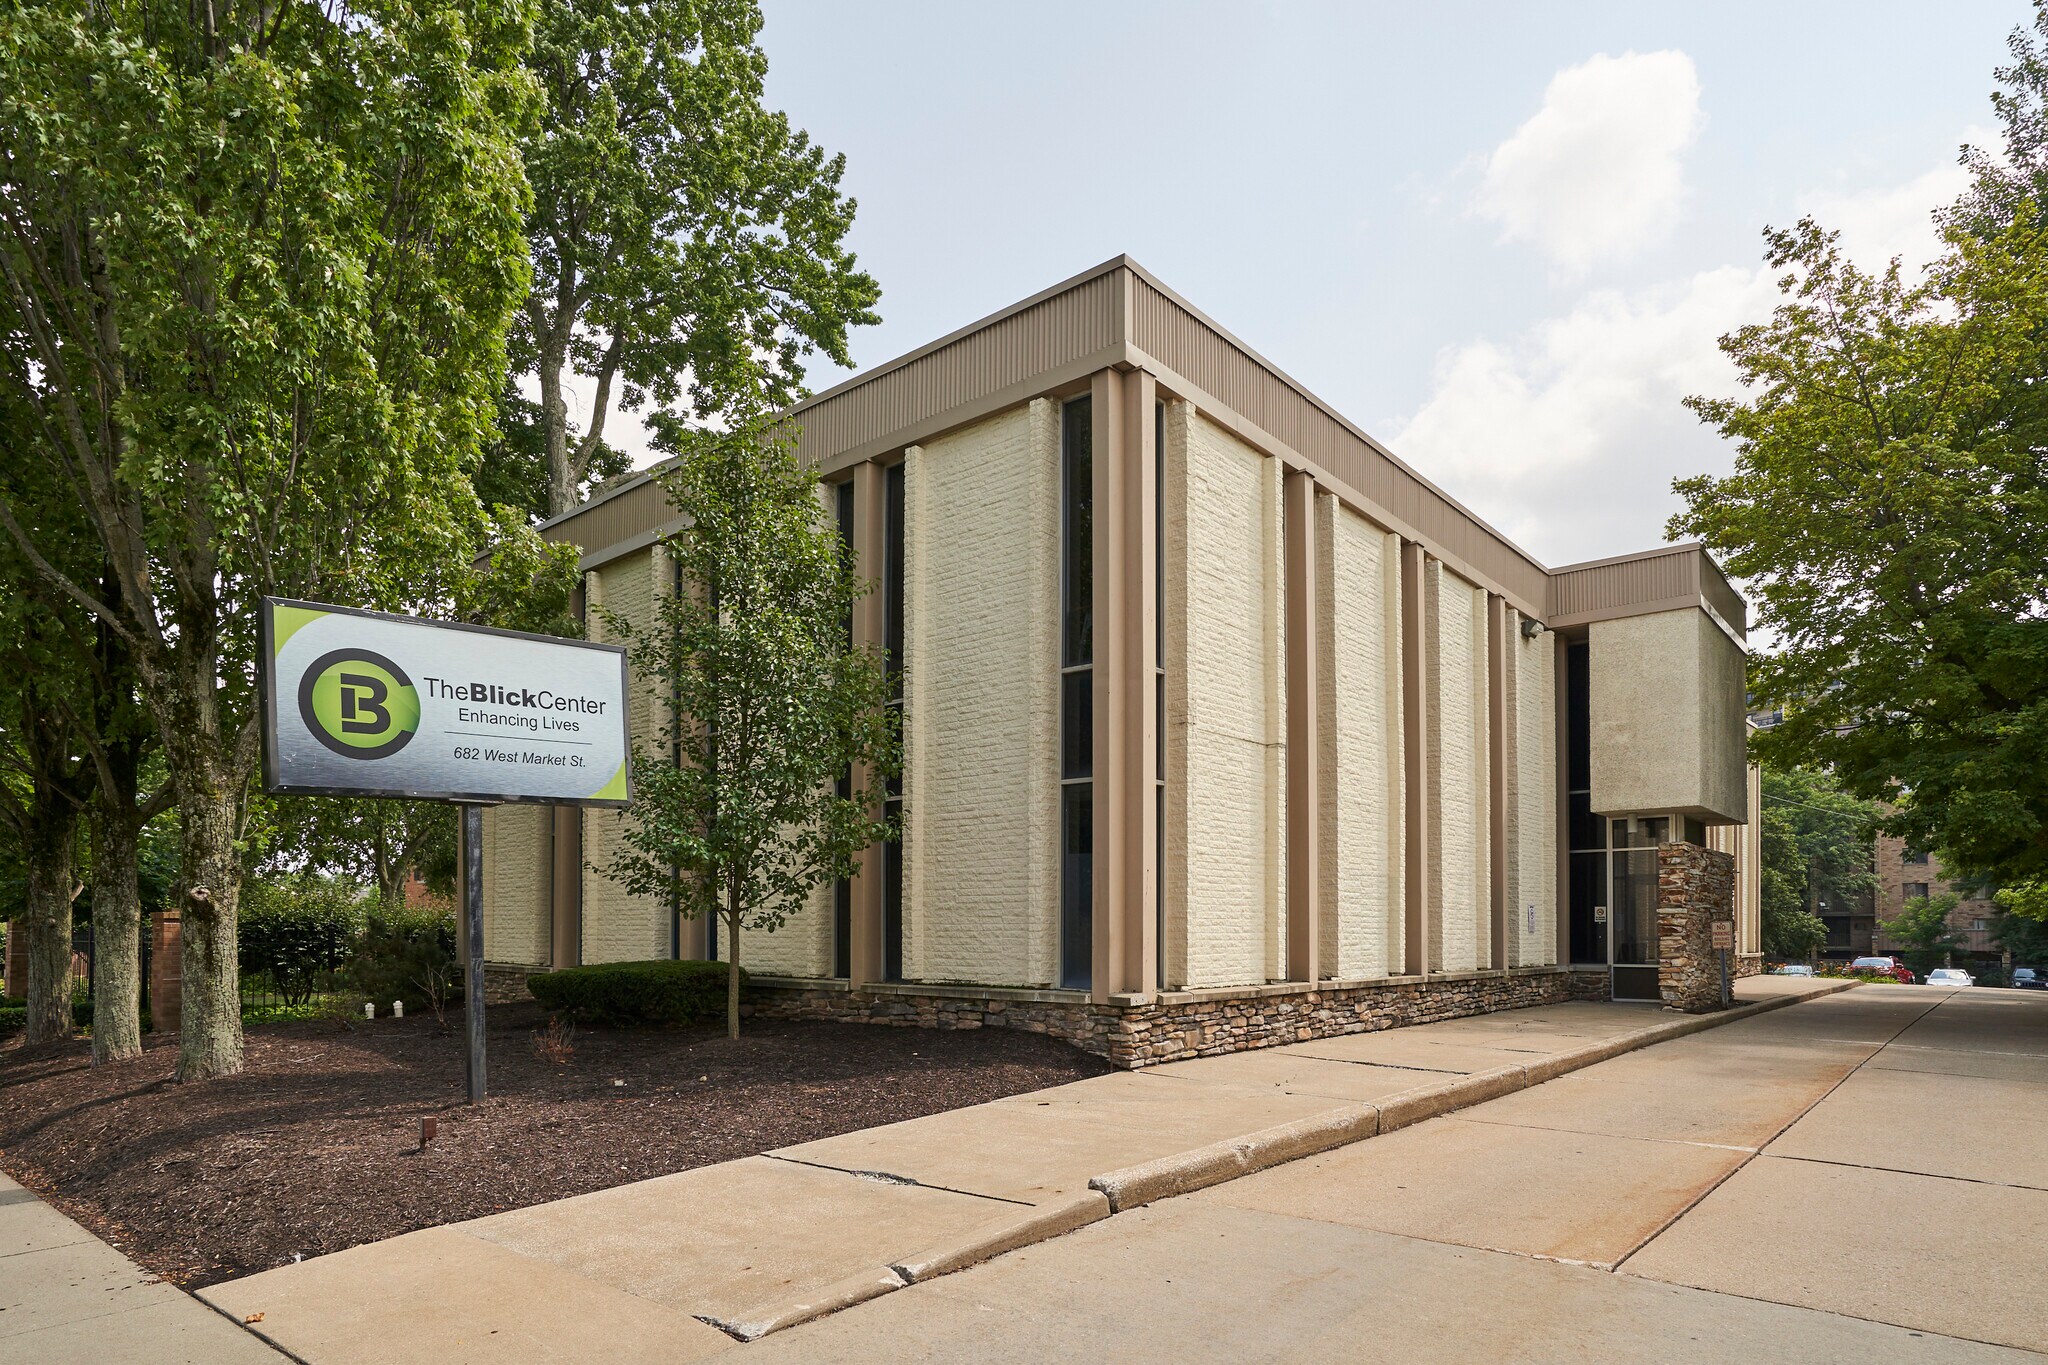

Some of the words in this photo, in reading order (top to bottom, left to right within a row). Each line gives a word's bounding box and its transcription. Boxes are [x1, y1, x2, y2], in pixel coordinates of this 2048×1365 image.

[423, 677, 607, 715] TheBlickCenter
[458, 708, 538, 731] Enhancing
[543, 716, 580, 732] Lives
[454, 746, 480, 760] 682
[484, 749, 518, 763] West
[522, 752, 566, 767] Market
[570, 755, 586, 768] St.
